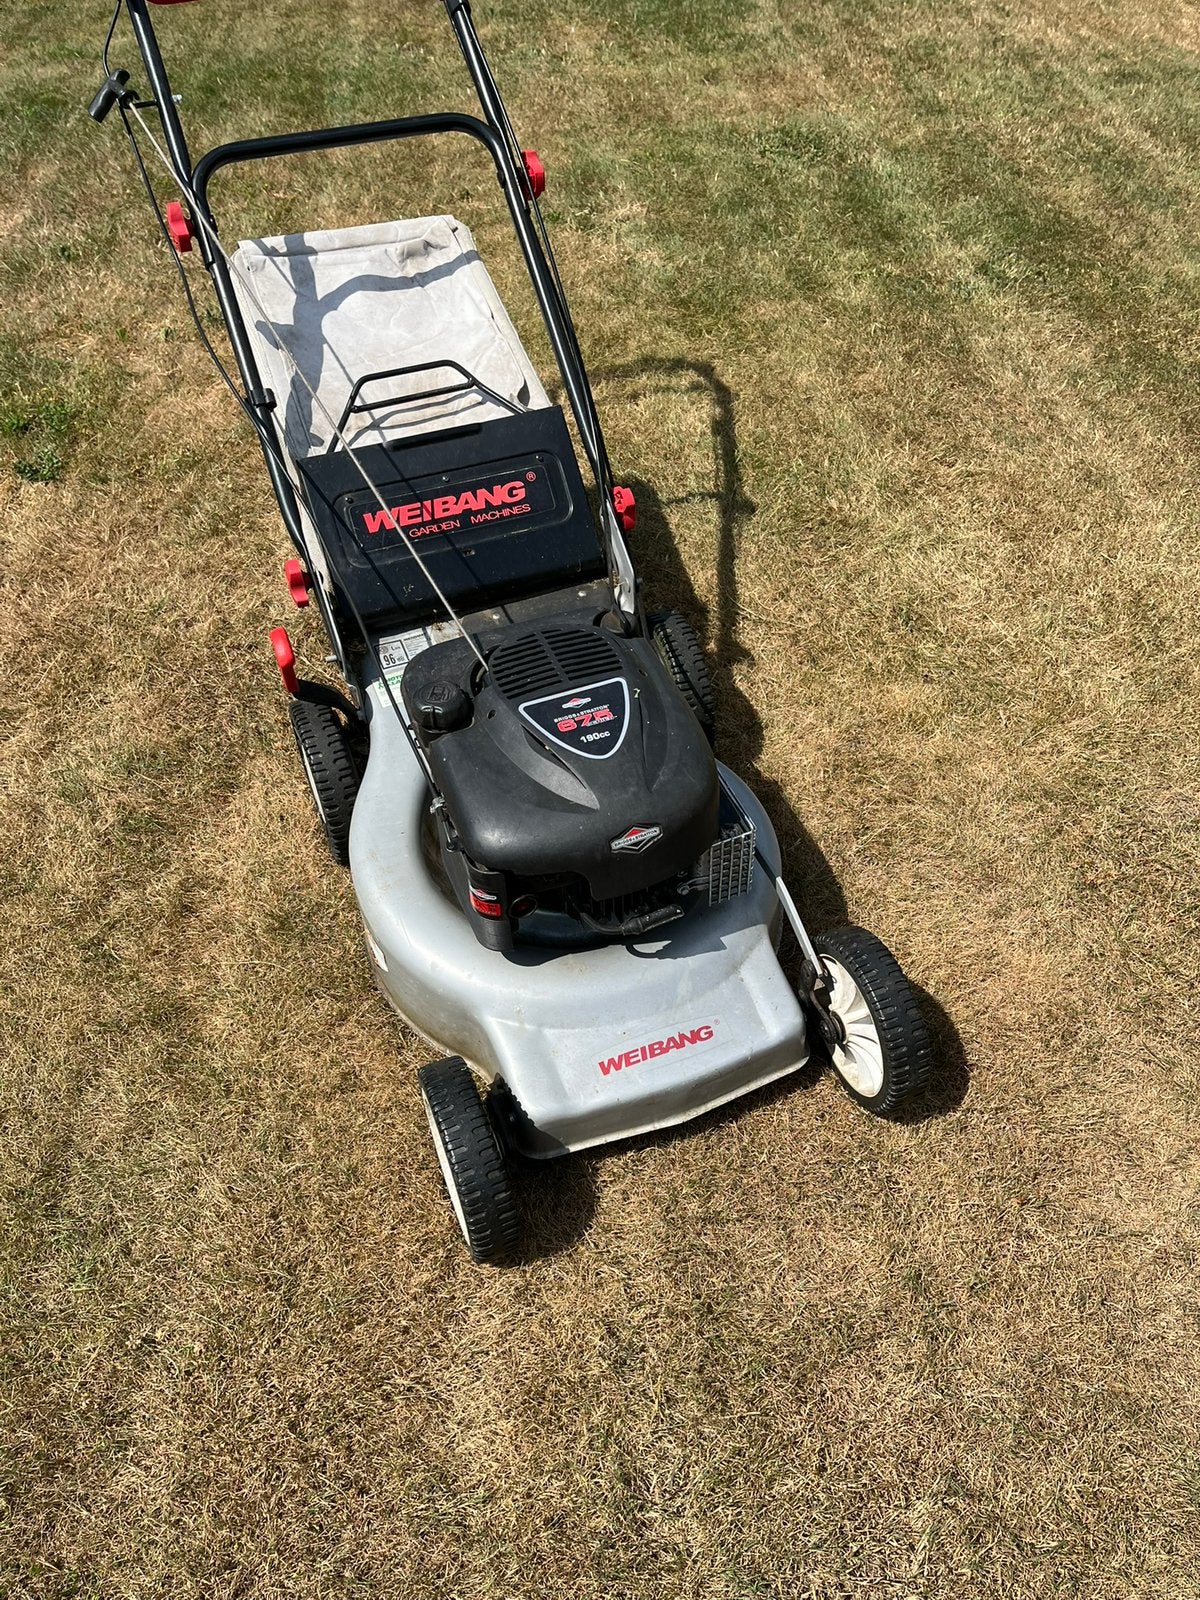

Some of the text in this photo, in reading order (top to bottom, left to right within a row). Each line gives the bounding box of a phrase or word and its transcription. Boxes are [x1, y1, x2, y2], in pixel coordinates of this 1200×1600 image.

[362, 481, 526, 534] WEIBANG
[409, 503, 532, 538] GARDEN MACHINES
[383, 653, 397, 666] 96
[556, 708, 614, 733] 675
[580, 731, 611, 743] 190cc
[598, 1025, 714, 1076] WEIBANG
